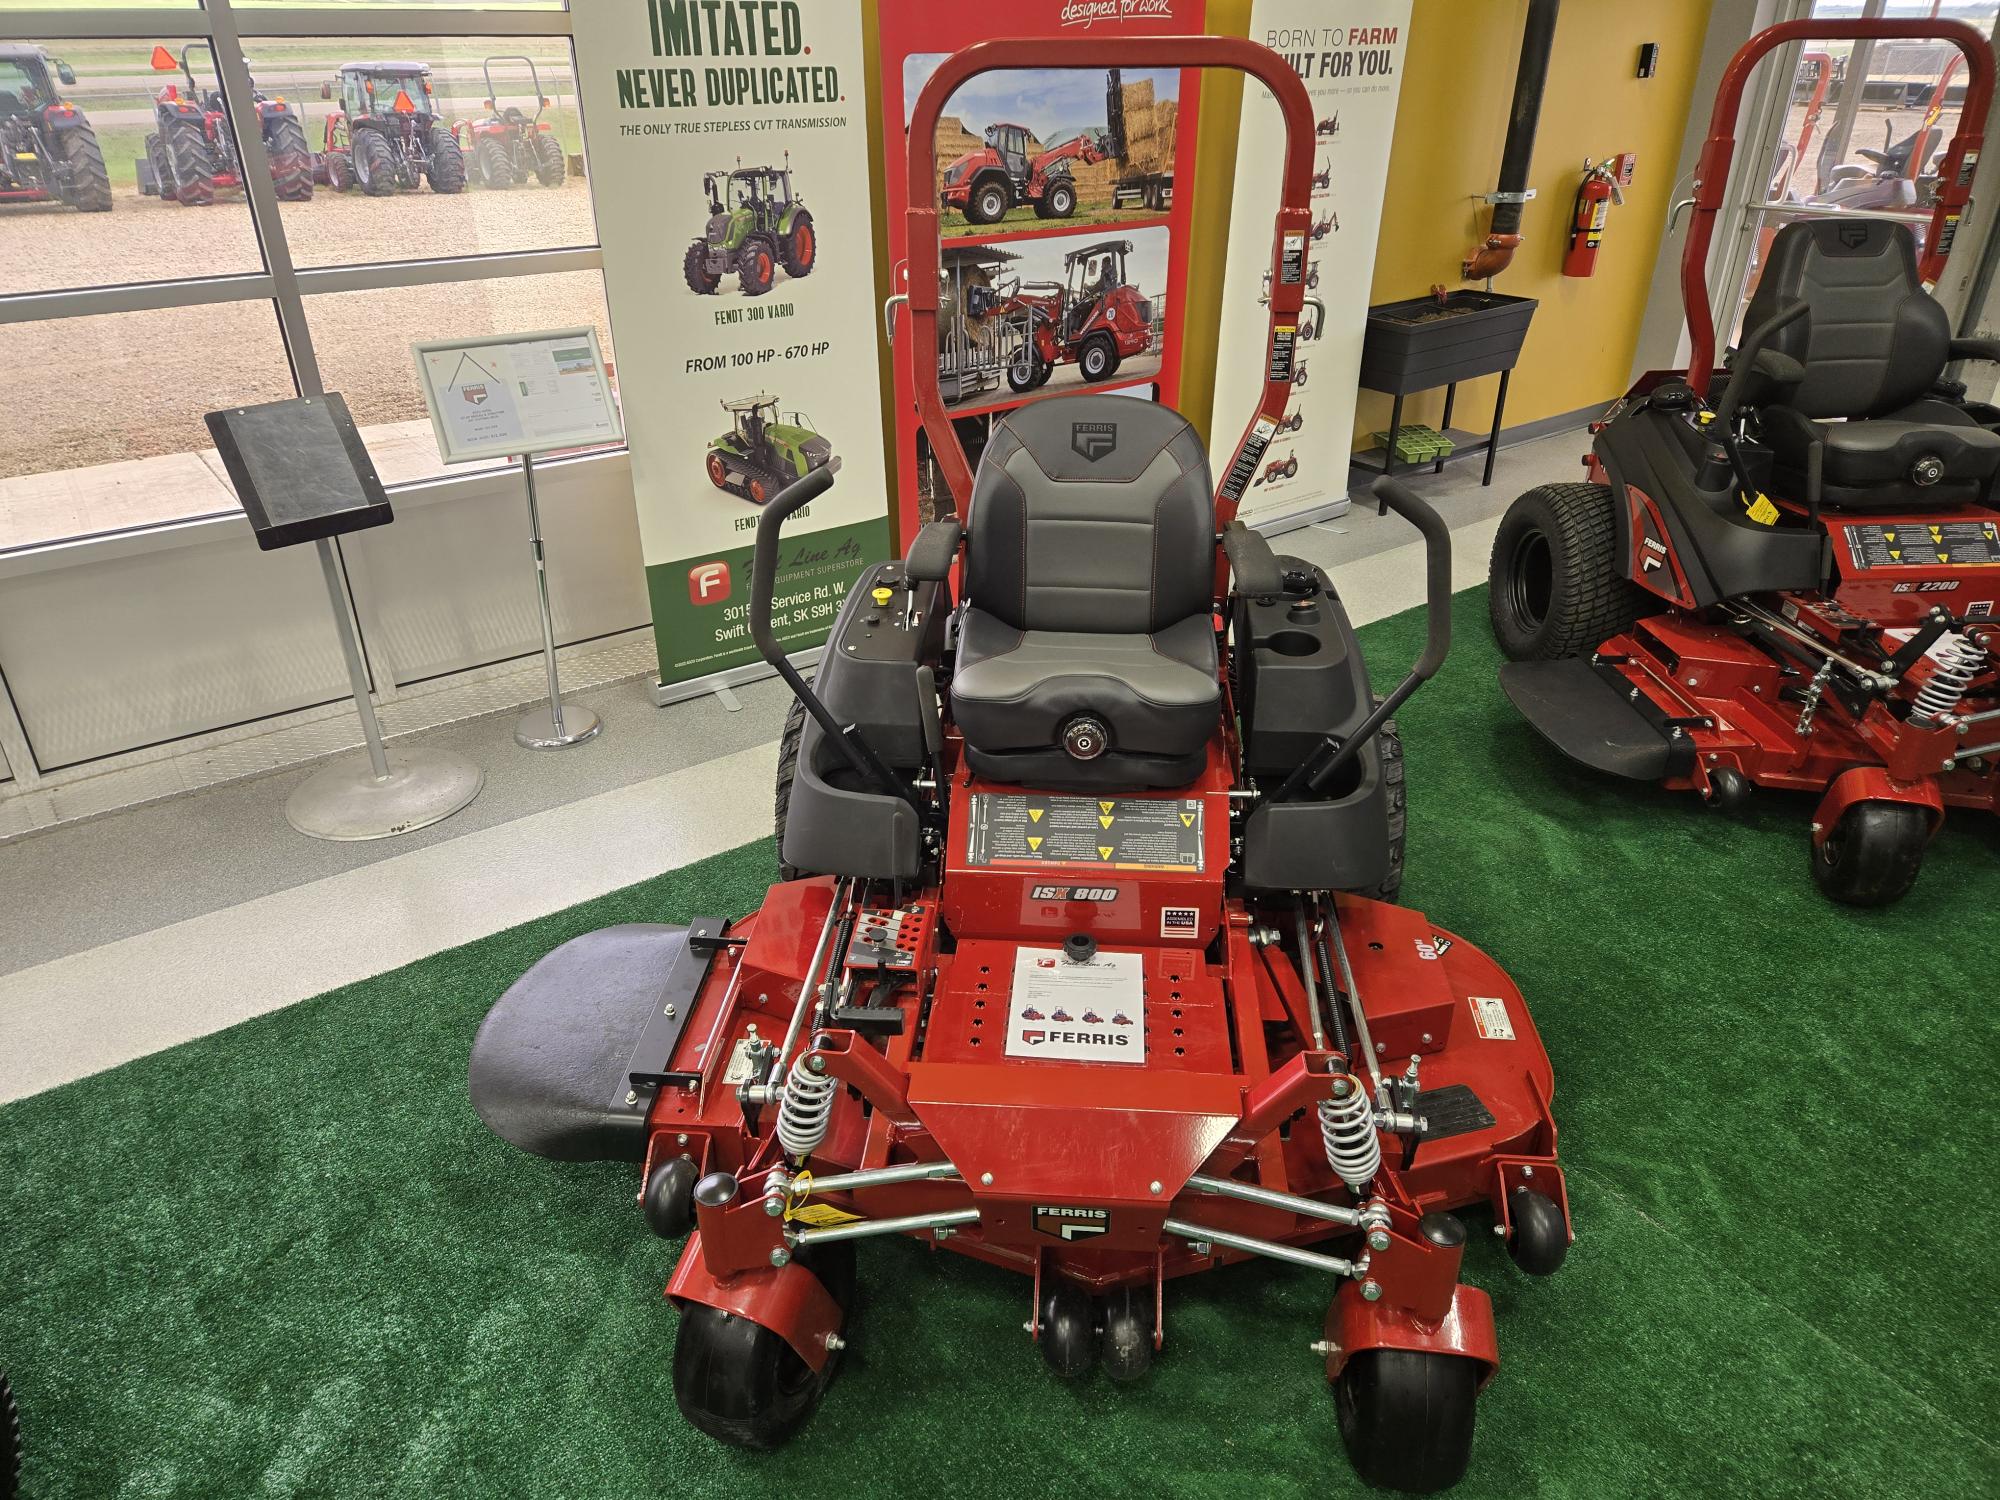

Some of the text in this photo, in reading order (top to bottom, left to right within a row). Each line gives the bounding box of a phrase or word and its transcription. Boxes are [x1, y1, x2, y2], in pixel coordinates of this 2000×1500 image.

[1061, 0, 1117, 29] designed
[1118, 0, 1137, 23] for
[647, 0, 811, 56] IMITATED.
[1267, 27, 1397, 47] BORN TO FARM
[1319, 51, 1353, 78] FOR
[1359, 49, 1393, 76] YOU.
[616, 66, 845, 108] NEVER DUPLICATED.
[620, 116, 847, 136] THE ONLY TRUE STEPLESS CVT TRANSMISSION
[714, 302, 794, 326] FENDT 300 VARIO
[685, 355, 727, 373] FROM
[731, 351, 753, 367] 100
[756, 349, 775, 363] HP
[785, 344, 808, 359] 670
[811, 341, 830, 356] HP
[1076, 424, 1113, 432] FERRIS
[1644, 537, 1667, 554] FERRIS
[774, 557, 864, 584] QUIPMENT SUPERSTORE
[771, 592, 811, 610] Service
[814, 587, 832, 603] Rd.
[833, 581, 846, 595] W.
[1893, 581, 1960, 593] ISX 2200
[715, 624, 745, 642] Swift
[793, 610, 809, 623] SK
[811, 604, 833, 619] S9H
[1032, 886, 1117, 900] ISX 800
[1049, 1031, 1128, 1046] FERRIS
[1037, 1207, 1107, 1218] FERRIS
